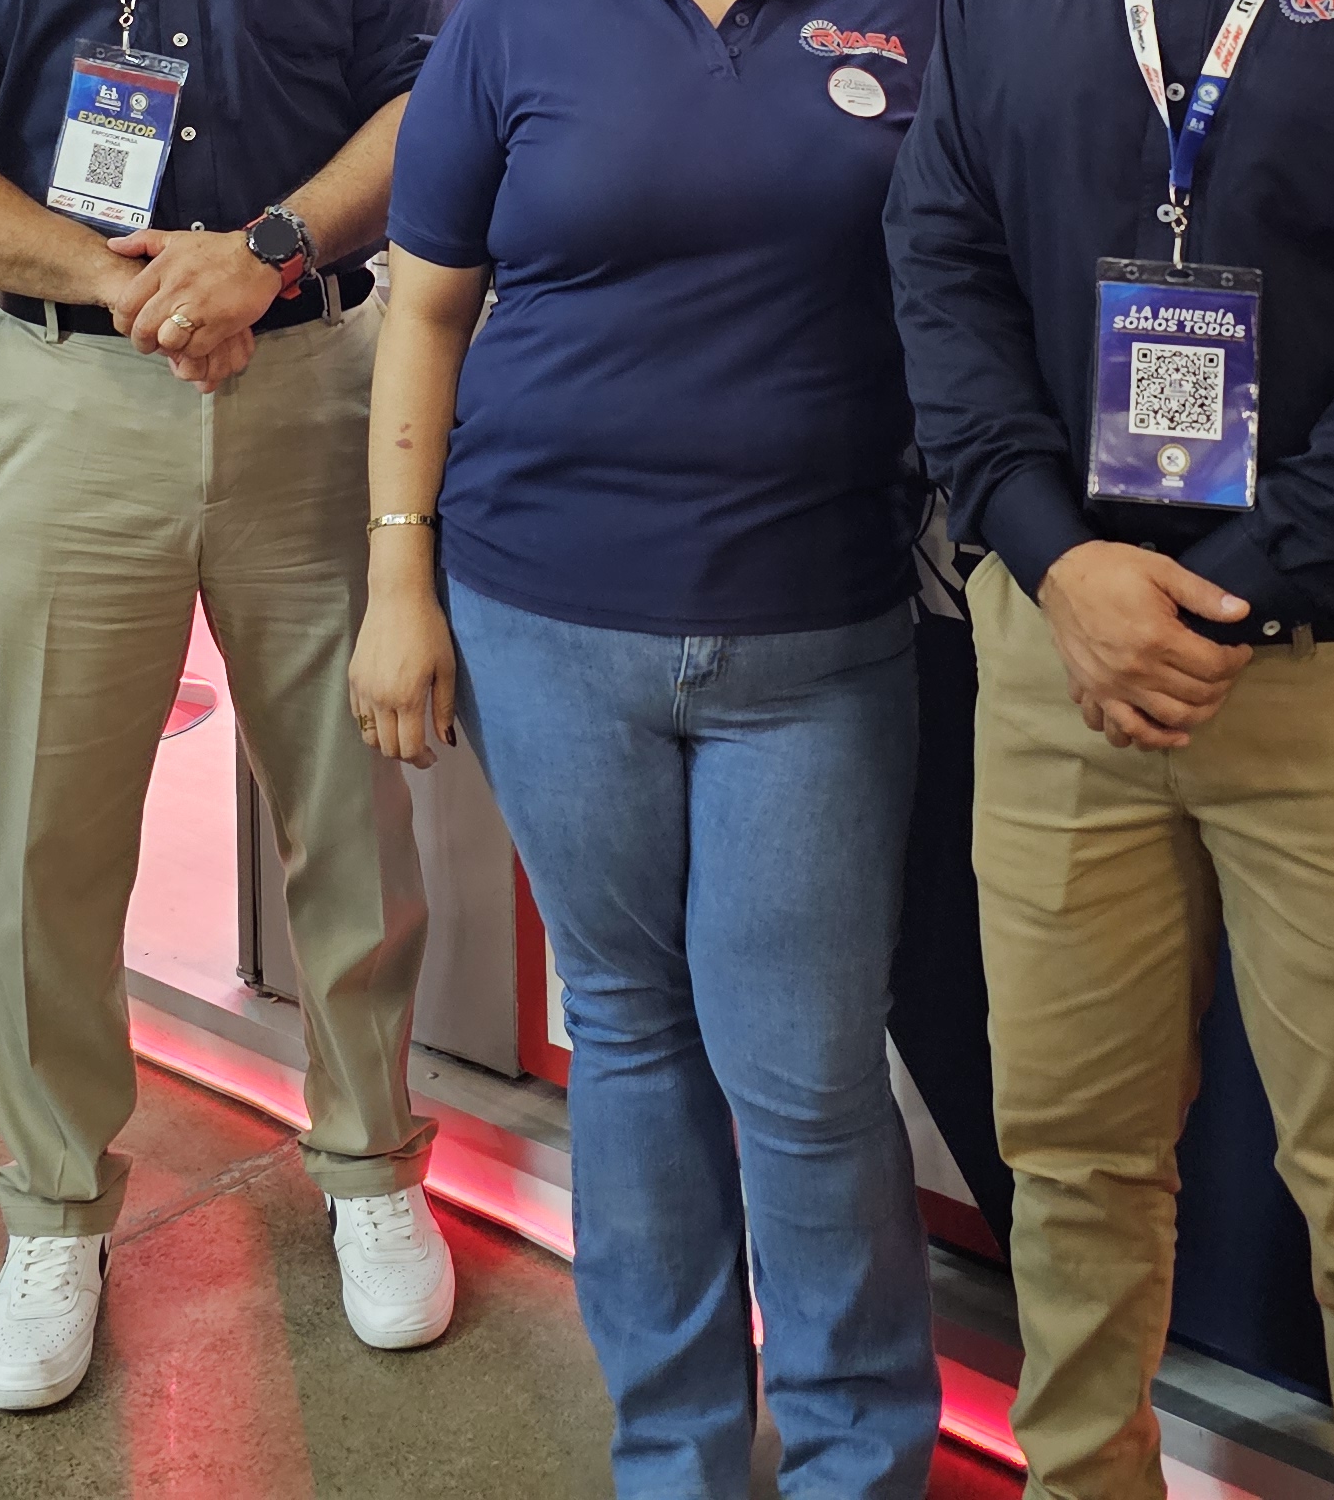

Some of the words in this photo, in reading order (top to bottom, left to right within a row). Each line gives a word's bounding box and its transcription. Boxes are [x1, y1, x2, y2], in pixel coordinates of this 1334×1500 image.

[811, 28, 907, 57] RYASA
[77, 110, 157, 139] EXPOSITOR
[1112, 315, 1178, 332] SOMOS
[1184, 321, 1246, 338] TODOS
[1129, 305, 1153, 320] LA
[1159, 307, 1235, 326] MINERÍA
